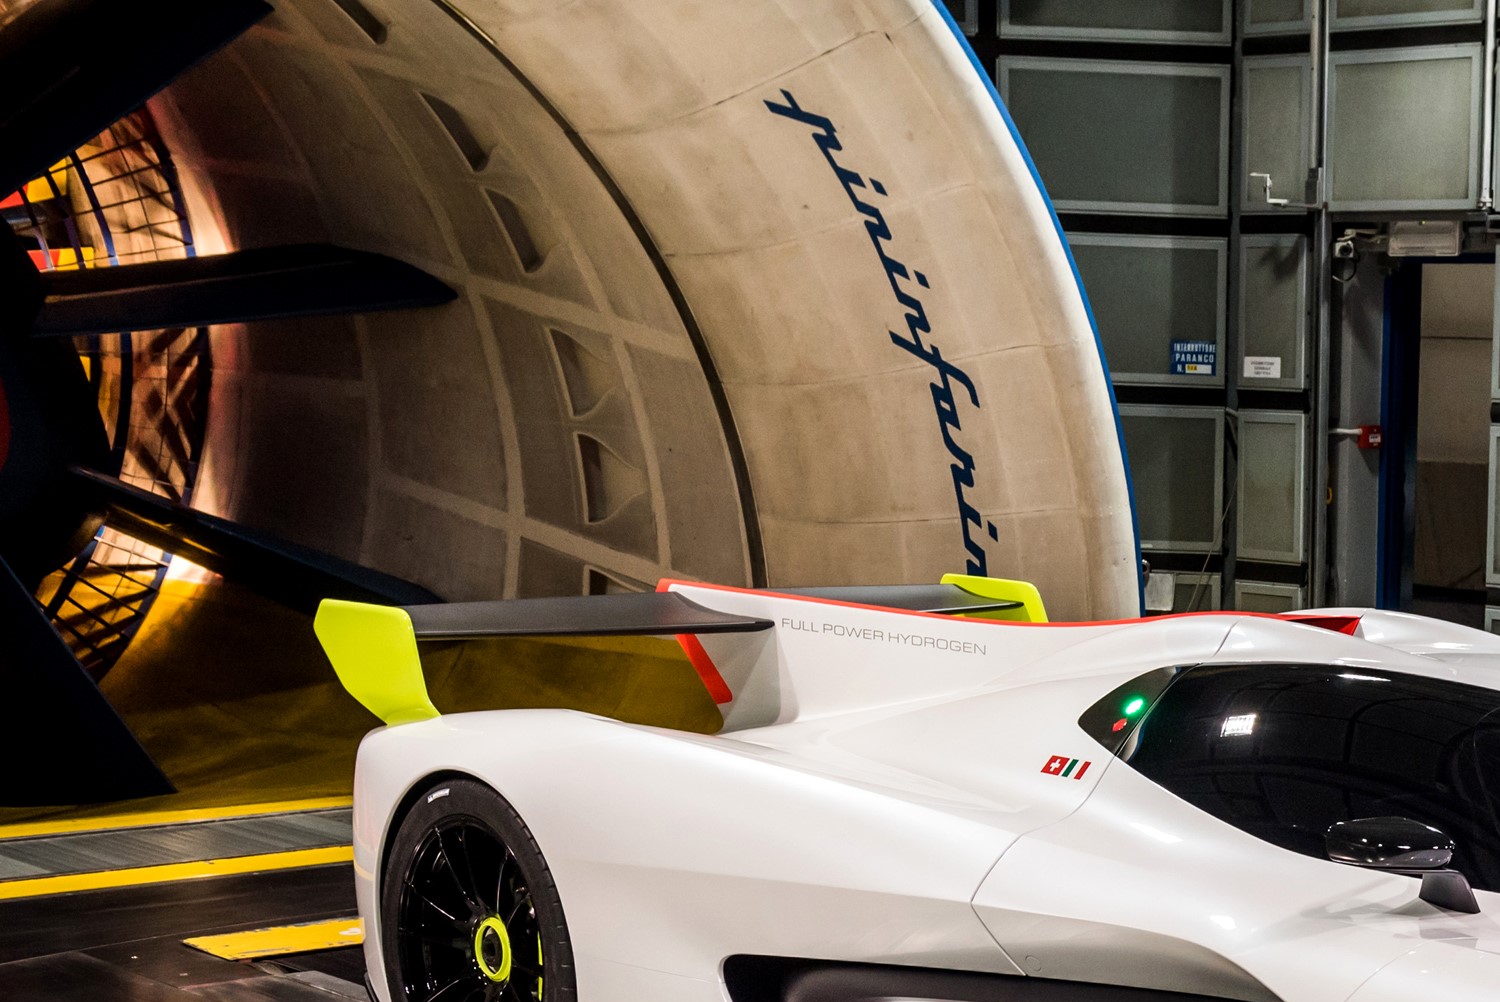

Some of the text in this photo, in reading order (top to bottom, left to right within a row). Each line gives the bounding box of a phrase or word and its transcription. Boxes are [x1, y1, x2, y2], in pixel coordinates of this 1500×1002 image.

[763, 88, 998, 577] pininfarin
[1174, 343, 1216, 353] INTERRUTTORE
[1175, 353, 1215, 363] PARANCO
[781, 618, 987, 655] FULL POWER HYDROGEN
